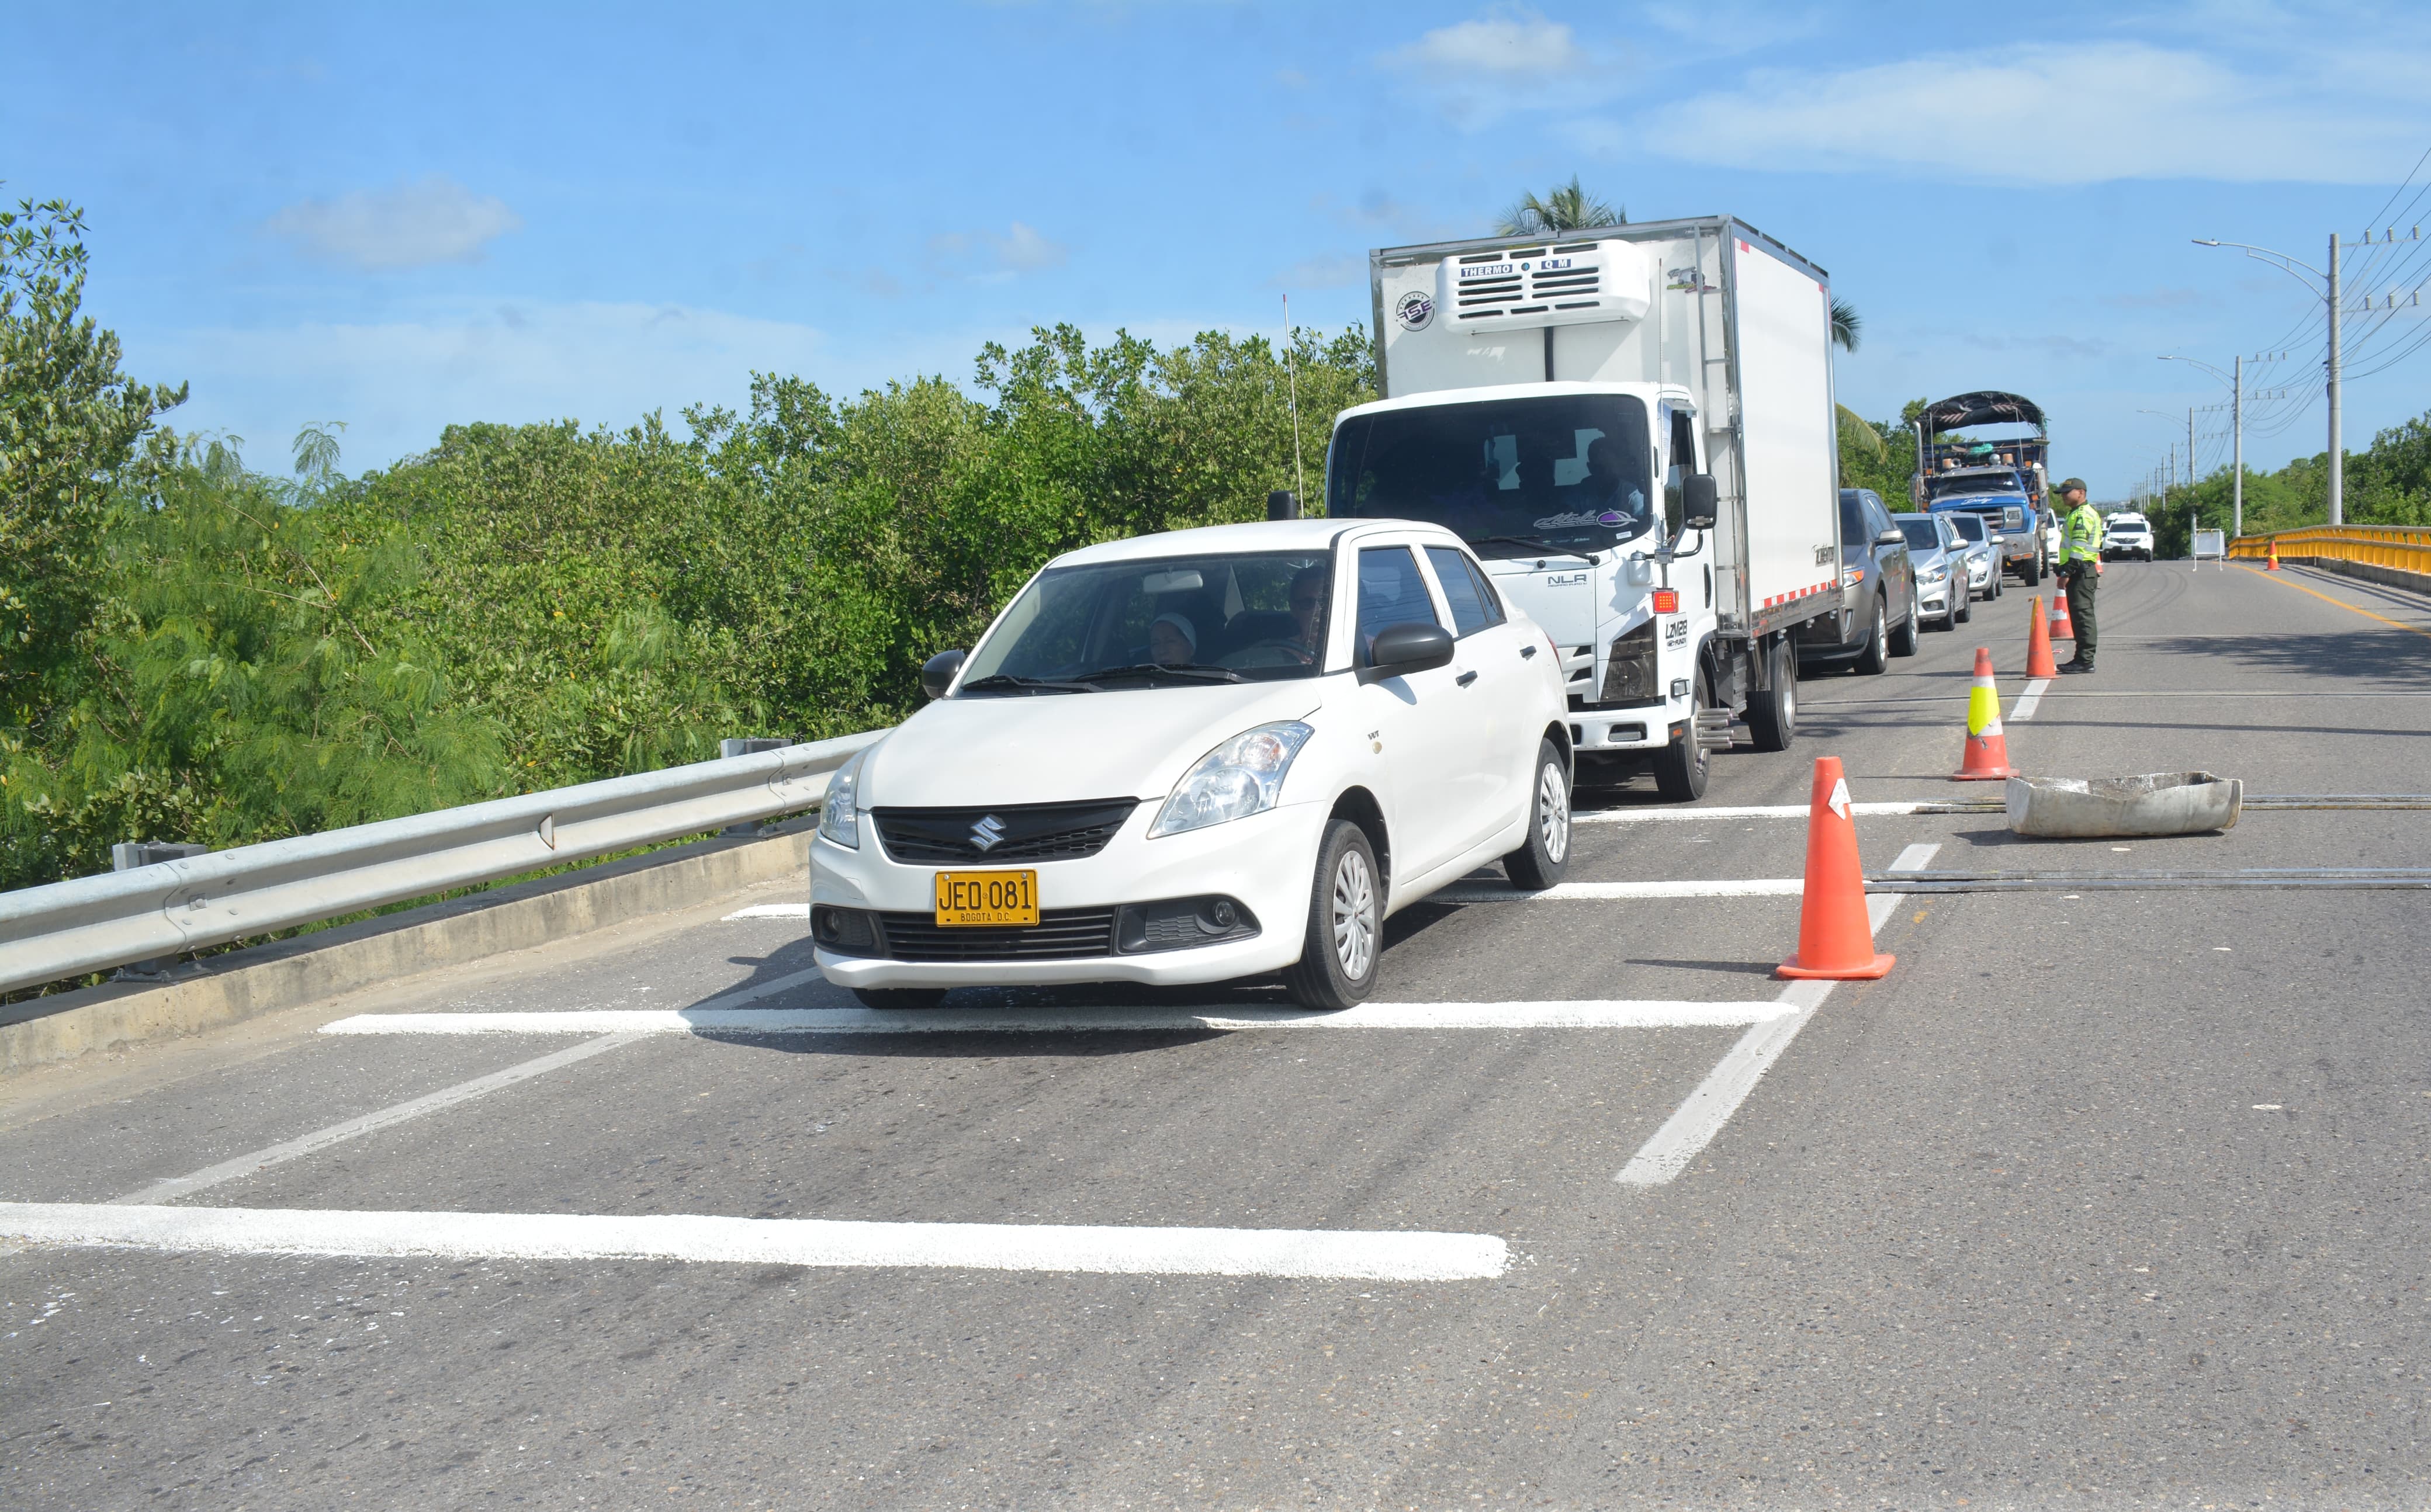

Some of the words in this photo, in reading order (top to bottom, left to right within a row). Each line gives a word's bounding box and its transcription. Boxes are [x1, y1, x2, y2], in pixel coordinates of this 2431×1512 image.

[1463, 265, 1511, 276] THERMO
[1547, 574, 1587, 585] NLR
[939, 881, 982, 911] JEO
[989, 880, 1032, 910] 081
[961, 913, 992, 921] BOGOTA
[998, 912, 1012, 921] D.C.
